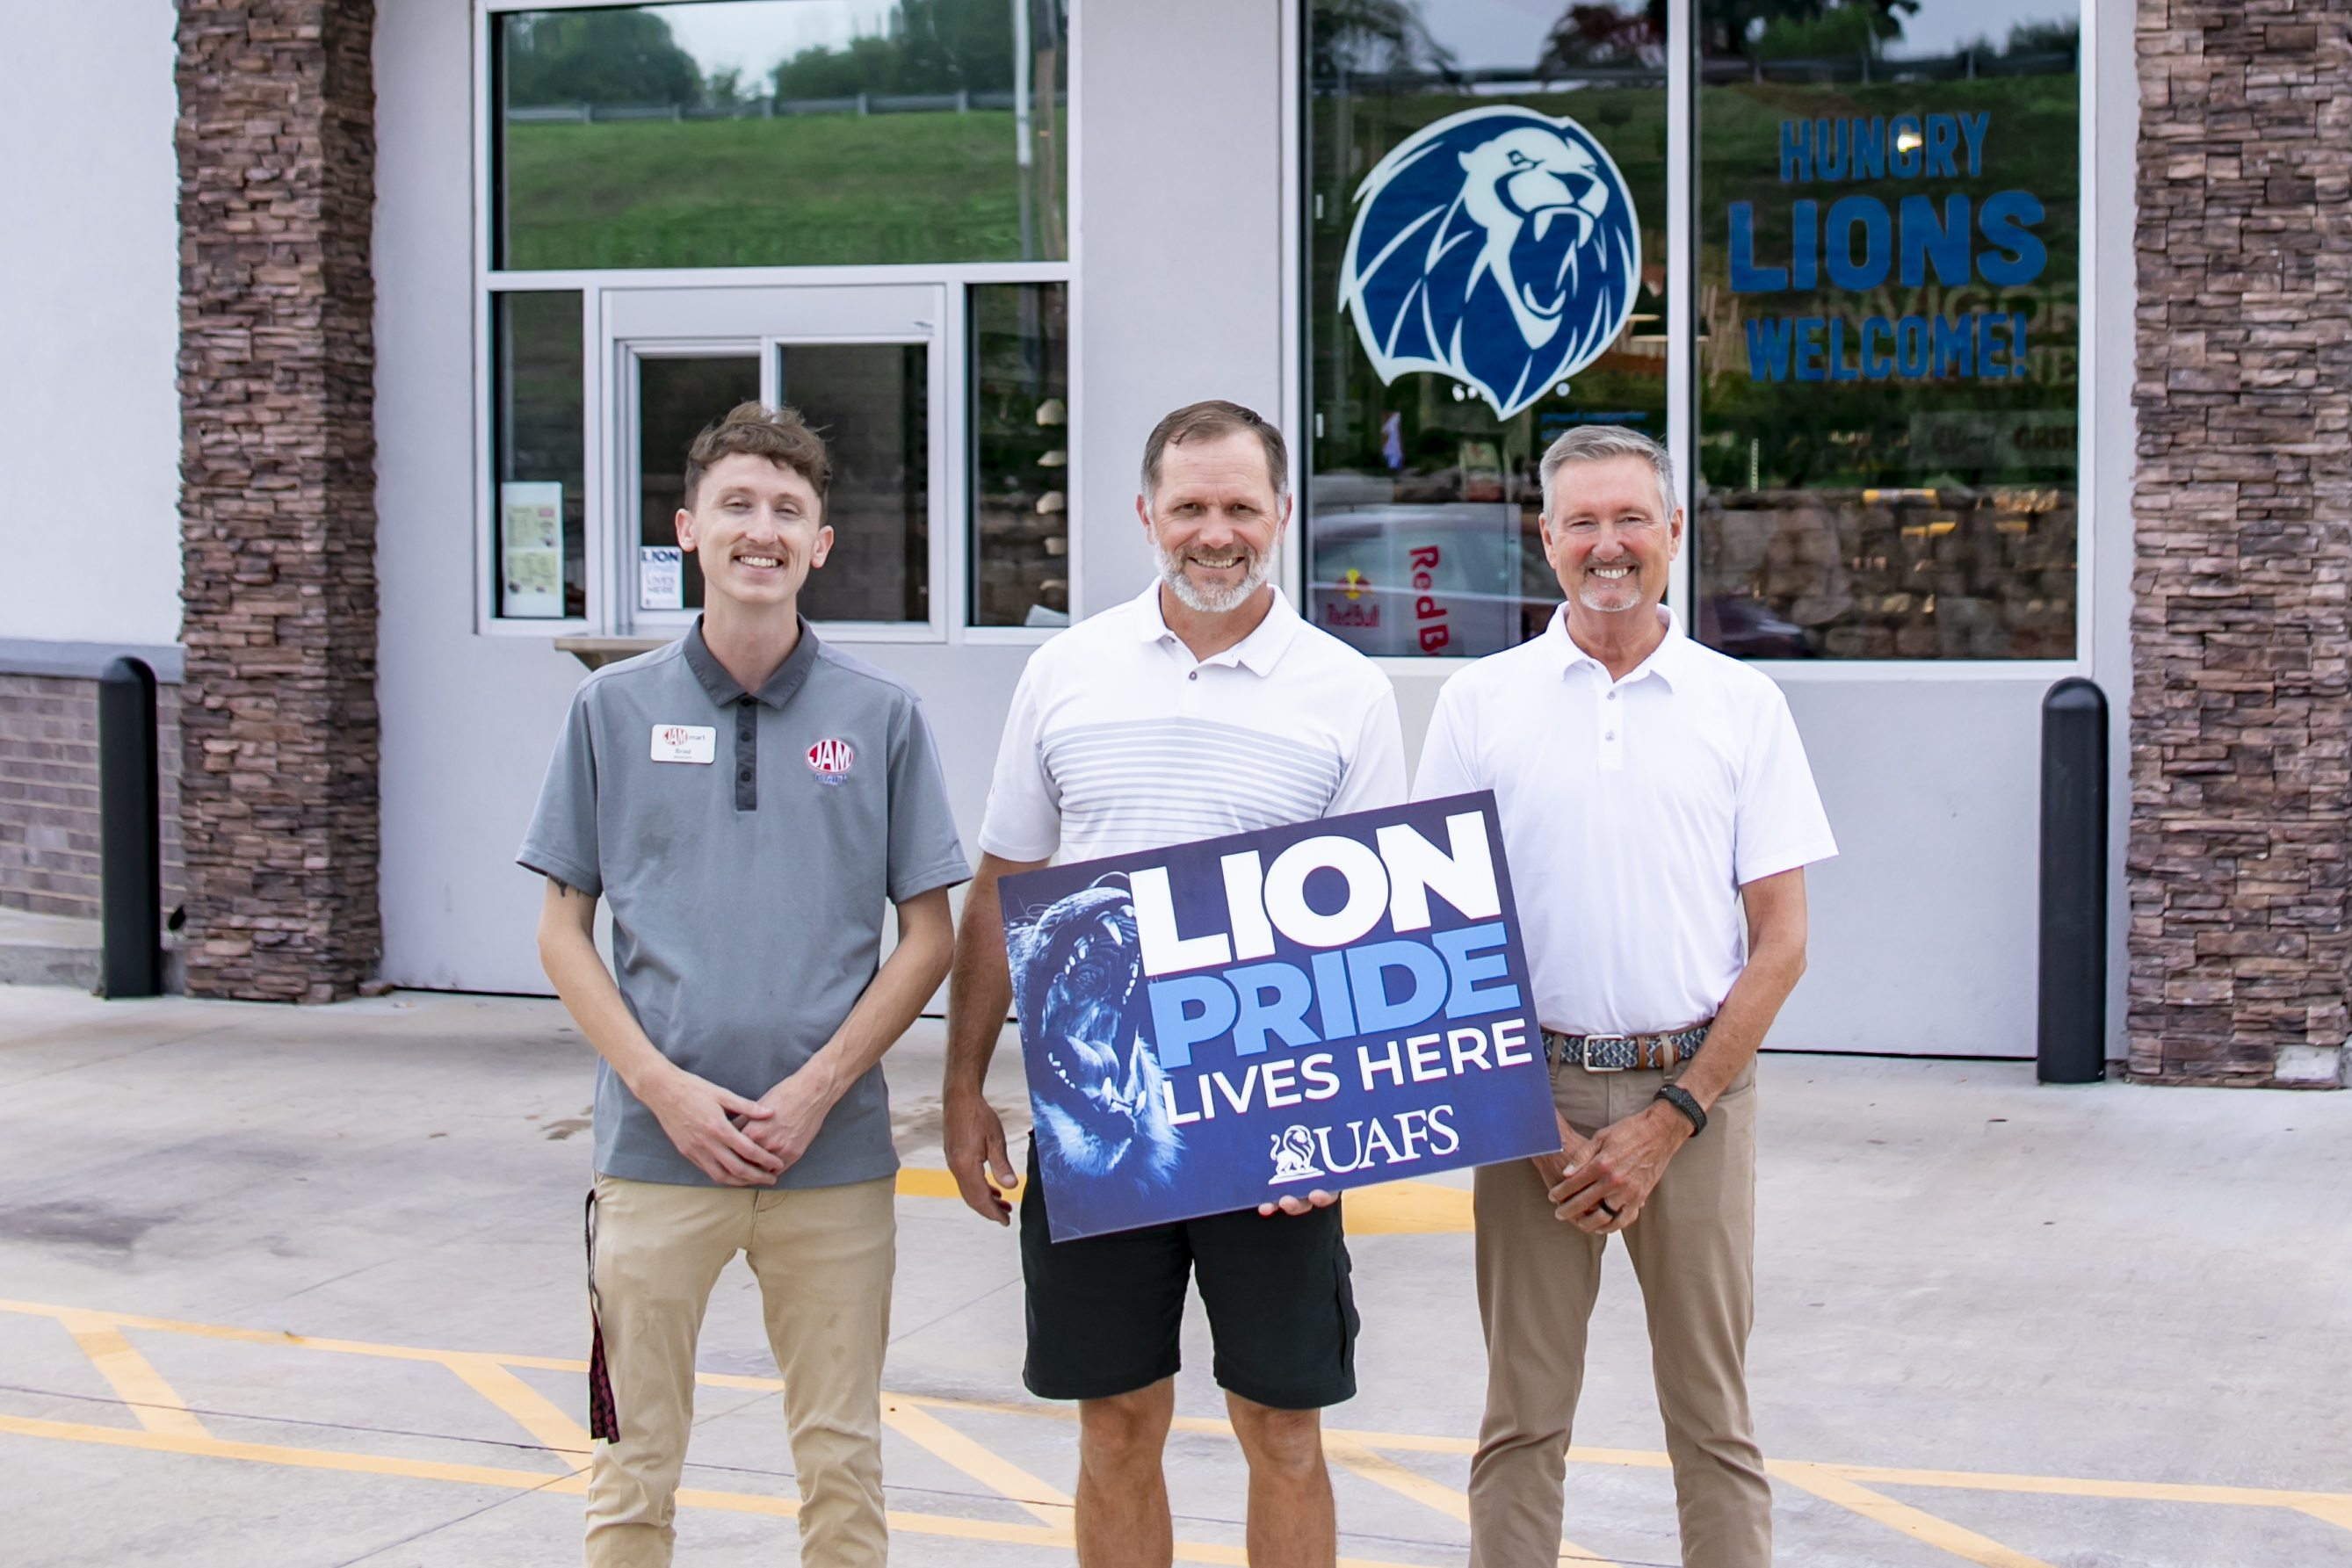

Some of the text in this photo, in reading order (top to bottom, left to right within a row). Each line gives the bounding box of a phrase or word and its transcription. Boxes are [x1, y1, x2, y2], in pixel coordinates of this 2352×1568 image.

[1780, 112, 1991, 183] HUNGRY
[1728, 191, 2048, 293] LIONS
[1746, 313, 2027, 381] WELCOME!
[1409, 546, 1448, 619] Red
[663, 728, 688, 745] JAM
[807, 739, 852, 772] JAM
[1129, 810, 1502, 977] LION
[1148, 921, 1522, 1069] PRIDE
[1162, 1018, 1532, 1125] LIVES HERE
[1313, 1104, 1460, 1174] UAFS
